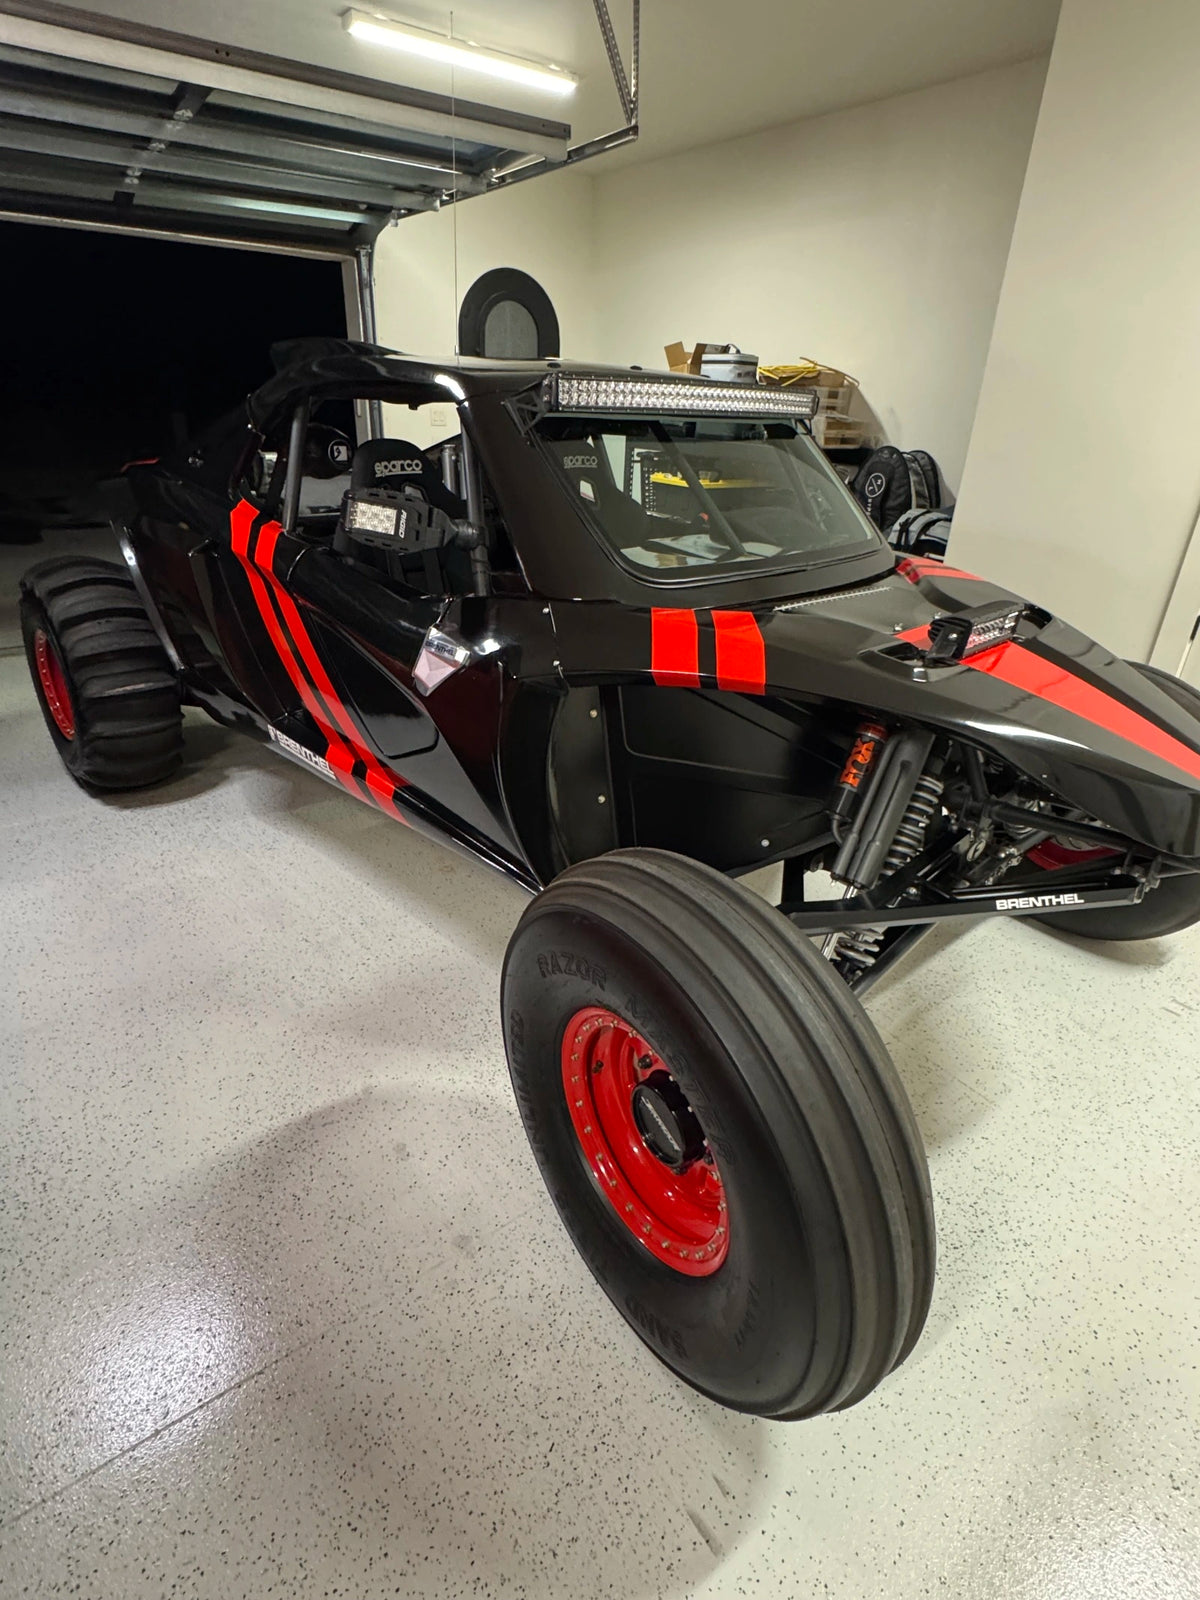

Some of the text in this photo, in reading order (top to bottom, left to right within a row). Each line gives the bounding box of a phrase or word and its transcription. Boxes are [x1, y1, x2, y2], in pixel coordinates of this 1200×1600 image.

[374, 459, 423, 477] sparco
[564, 455, 598, 469] sparco
[398, 510, 407, 538] RIGID
[276, 730, 335, 775] BRENTHEL
[840, 738, 876, 788] FOX
[995, 893, 1085, 911] BRENTHEL
[536, 950, 607, 990] RAZOR
